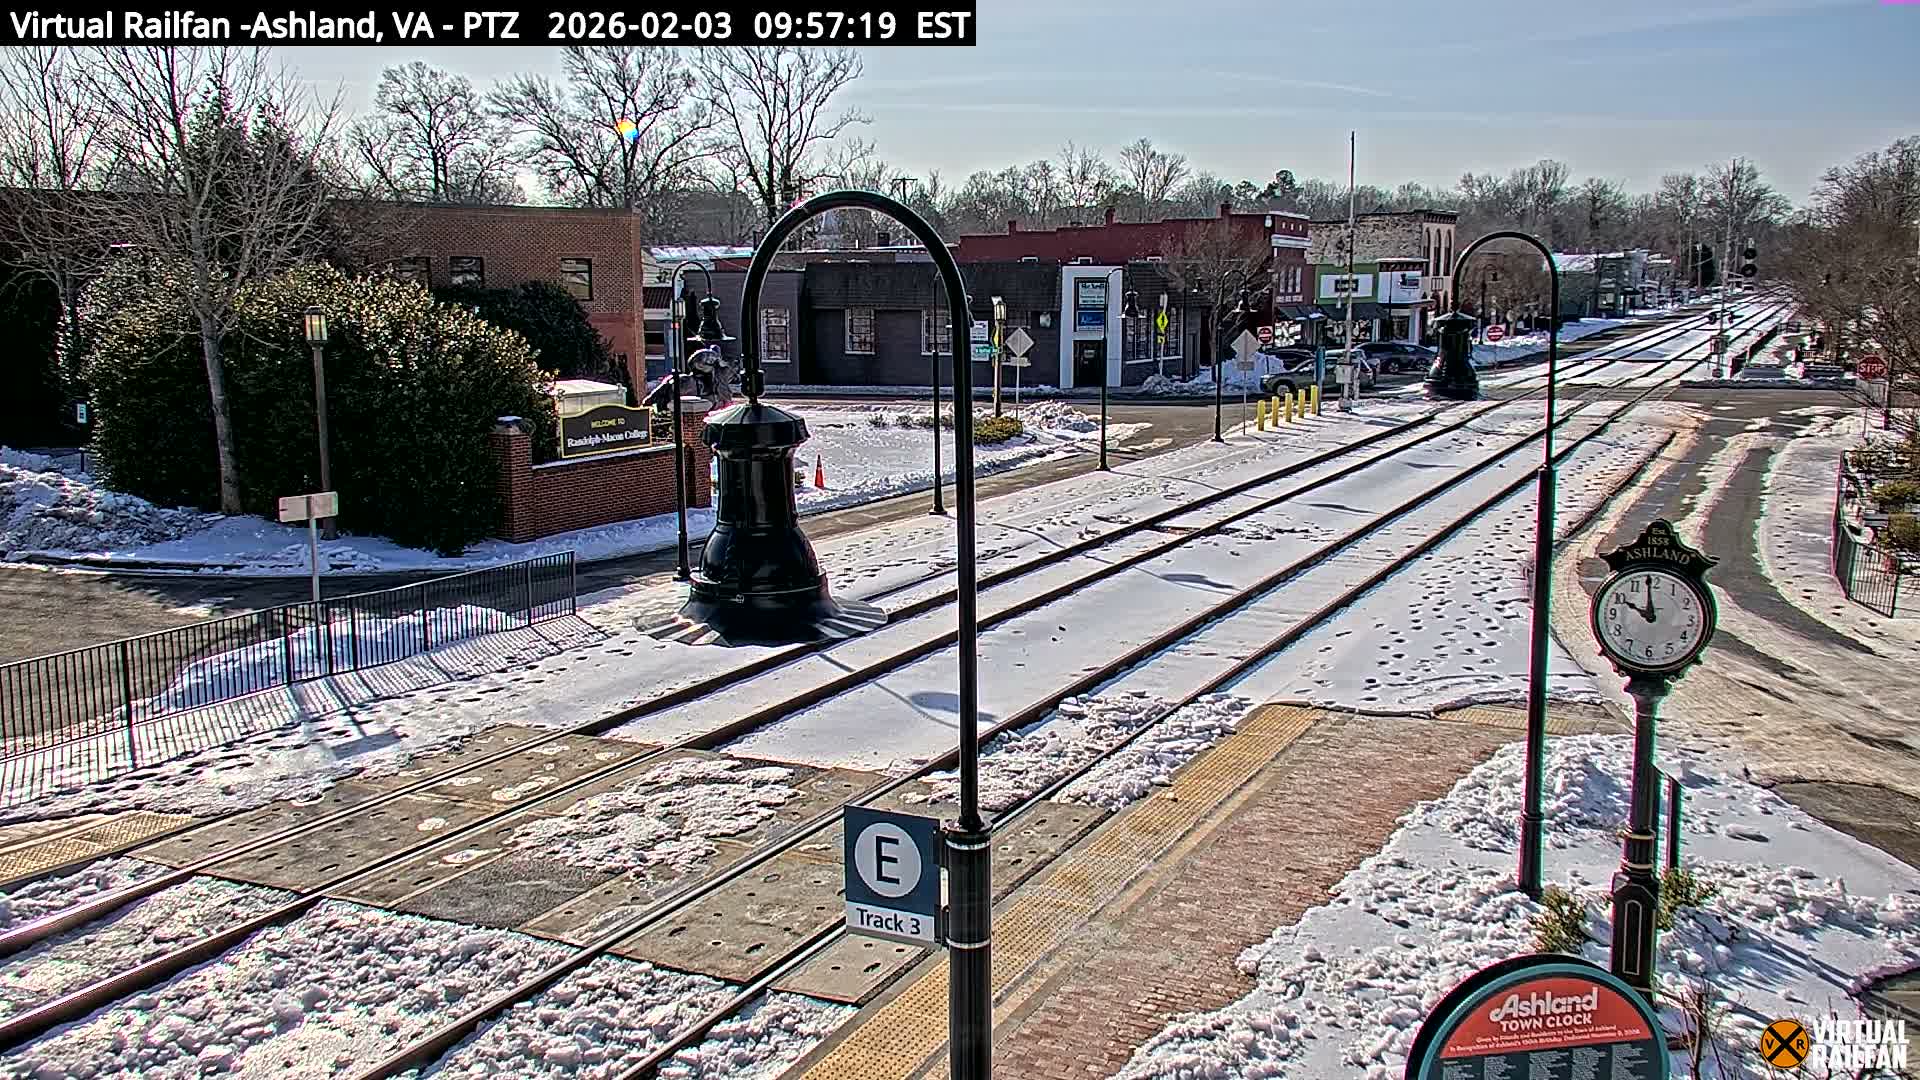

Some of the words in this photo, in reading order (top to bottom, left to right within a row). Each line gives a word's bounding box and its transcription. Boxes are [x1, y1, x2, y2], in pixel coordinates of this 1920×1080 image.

[1860, 363, 1885, 373] STOP
[624, 429, 649, 440] College
[1626, 547, 1691, 565] ASHLAND
[1630, 580, 1640, 593] 11
[1670, 583, 1676, 596] 1
[1614, 592, 1626, 605] 10
[1682, 597, 1691, 610] 2
[1609, 608, 1617, 620] 9
[1686, 614, 1695, 627] 3
[1613, 624, 1623, 637] 8
[1679, 629, 1688, 643] 4
[1624, 638, 1634, 651] 7
[1645, 645, 1653, 657] 6
[1664, 642, 1675, 655] 5
[876, 835, 900, 885] E
[856, 907, 904, 933] Track
[910, 917, 921, 935] 3
[1489, 986, 1599, 1022] Ashland
[1500, 1017, 1543, 1032] TOWN
[1546, 1012, 1592, 1028] CLOCK
